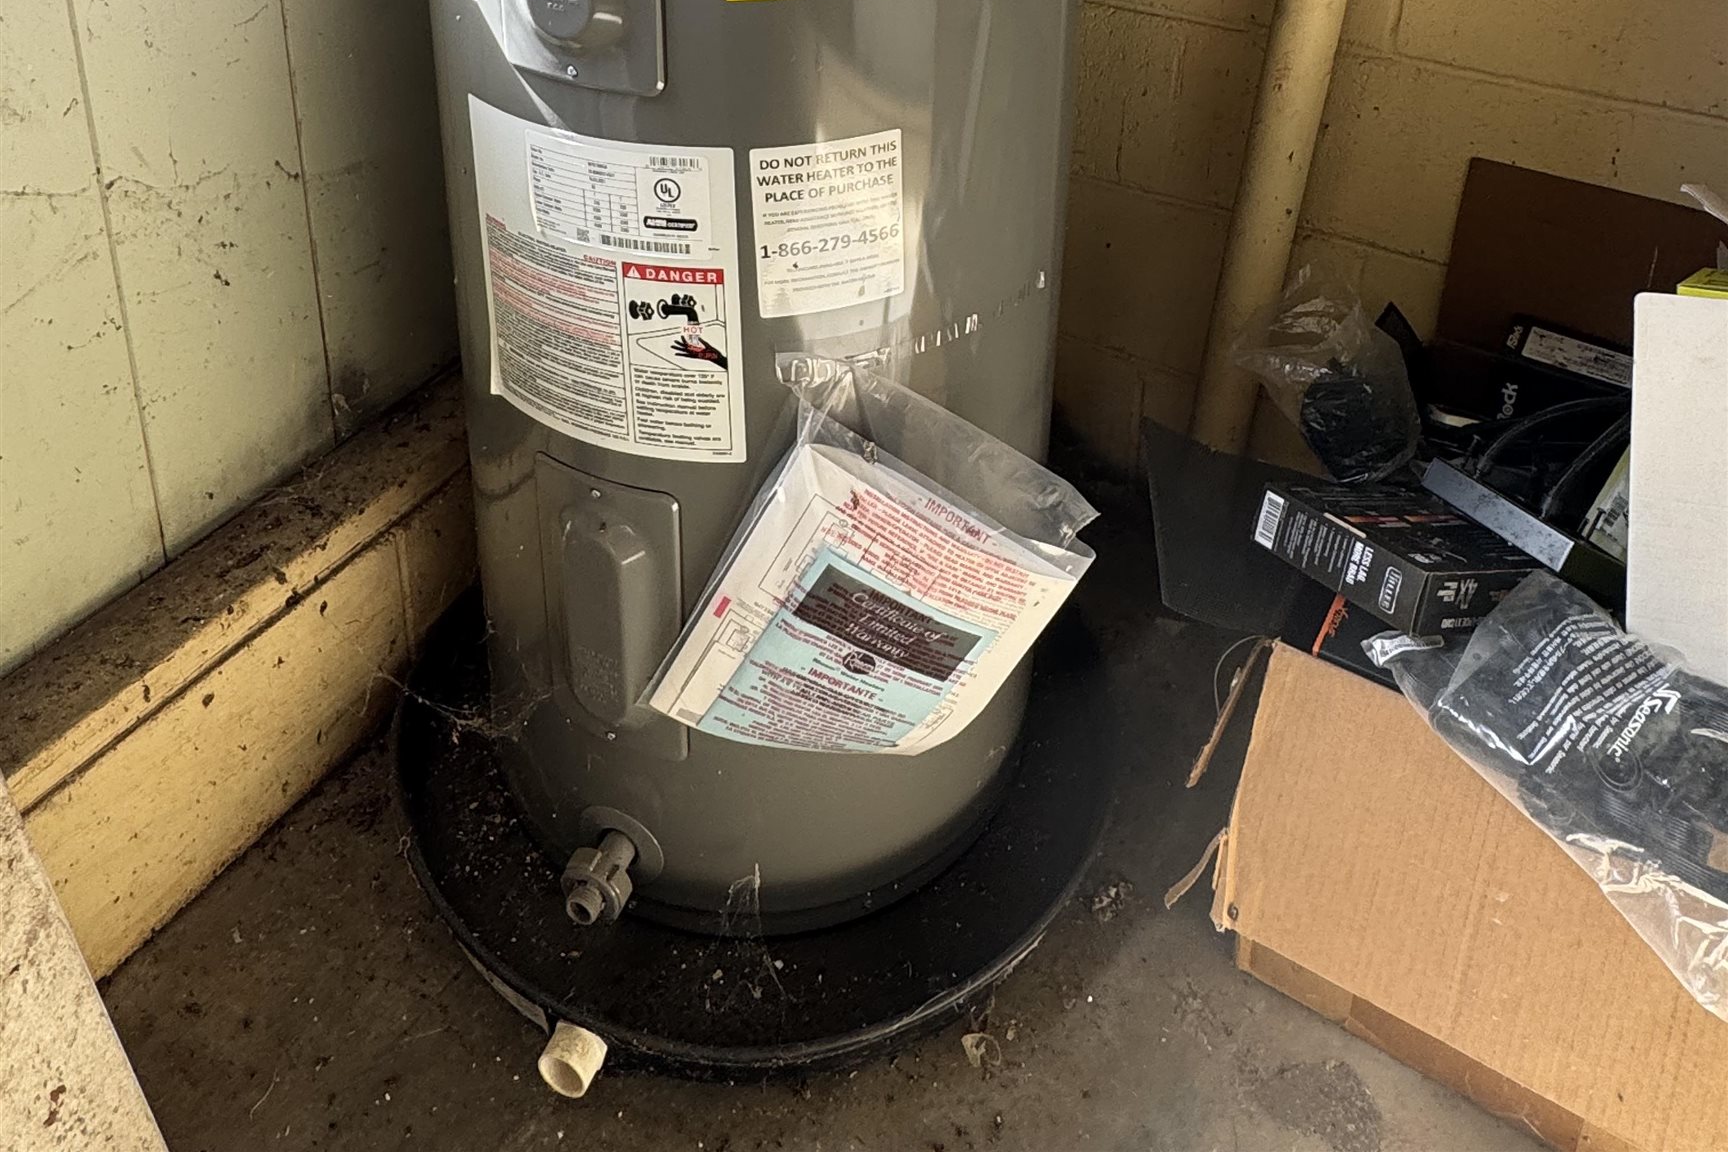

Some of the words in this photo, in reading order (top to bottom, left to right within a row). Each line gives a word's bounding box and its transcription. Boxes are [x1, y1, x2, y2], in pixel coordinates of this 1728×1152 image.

[759, 159, 780, 170] DO
[784, 155, 812, 168] NOT
[815, 146, 867, 165] RETURN
[870, 140, 897, 155] THIS
[757, 173, 804, 187] WATER
[806, 166, 854, 182] HEATER
[856, 161, 874, 174] TO
[876, 156, 898, 170] THE
[765, 189, 804, 203] PLACE
[808, 187, 825, 199] OF
[829, 173, 894, 196] PURCHASE
[760, 223, 899, 259] 1-866-279-4566
[646, 269, 717, 282] DANGER
[924, 497, 993, 545] IMPORTANT
[808, 667, 877, 699] IMPORTANTE
[1605, 690, 1671, 758] Seasonic
